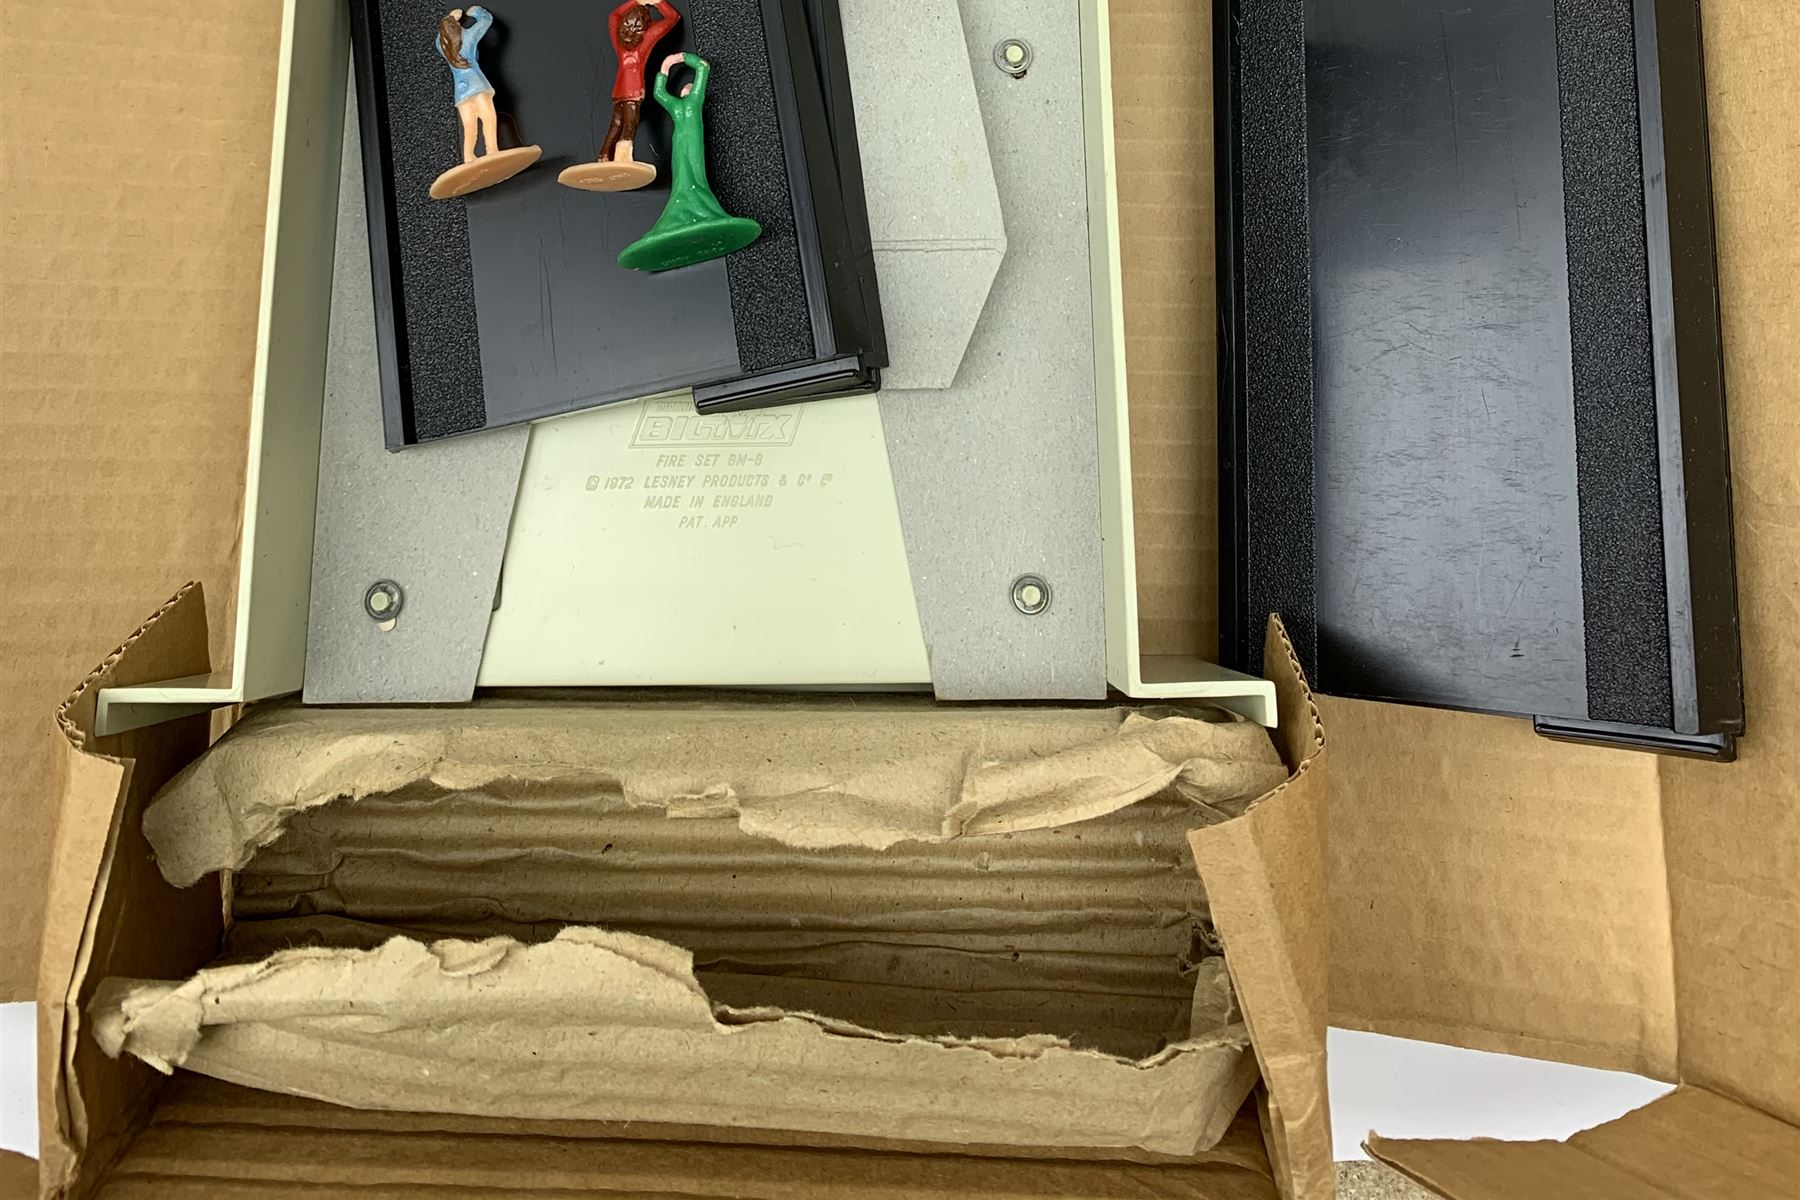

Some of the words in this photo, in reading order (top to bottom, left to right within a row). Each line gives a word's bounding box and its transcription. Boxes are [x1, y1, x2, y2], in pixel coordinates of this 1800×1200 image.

[656, 454, 687, 468] FIRE
[694, 453, 720, 467] SET
[604, 476, 634, 490] 1972
[643, 475, 695, 489] LESNEY
[702, 474, 770, 488] PRODUCTS
[779, 474, 788, 487] &
[643, 495, 681, 509] MADE
[689, 495, 704, 509] IN
[712, 495, 774, 508] ENGLAND
[712, 515, 739, 529] APP
